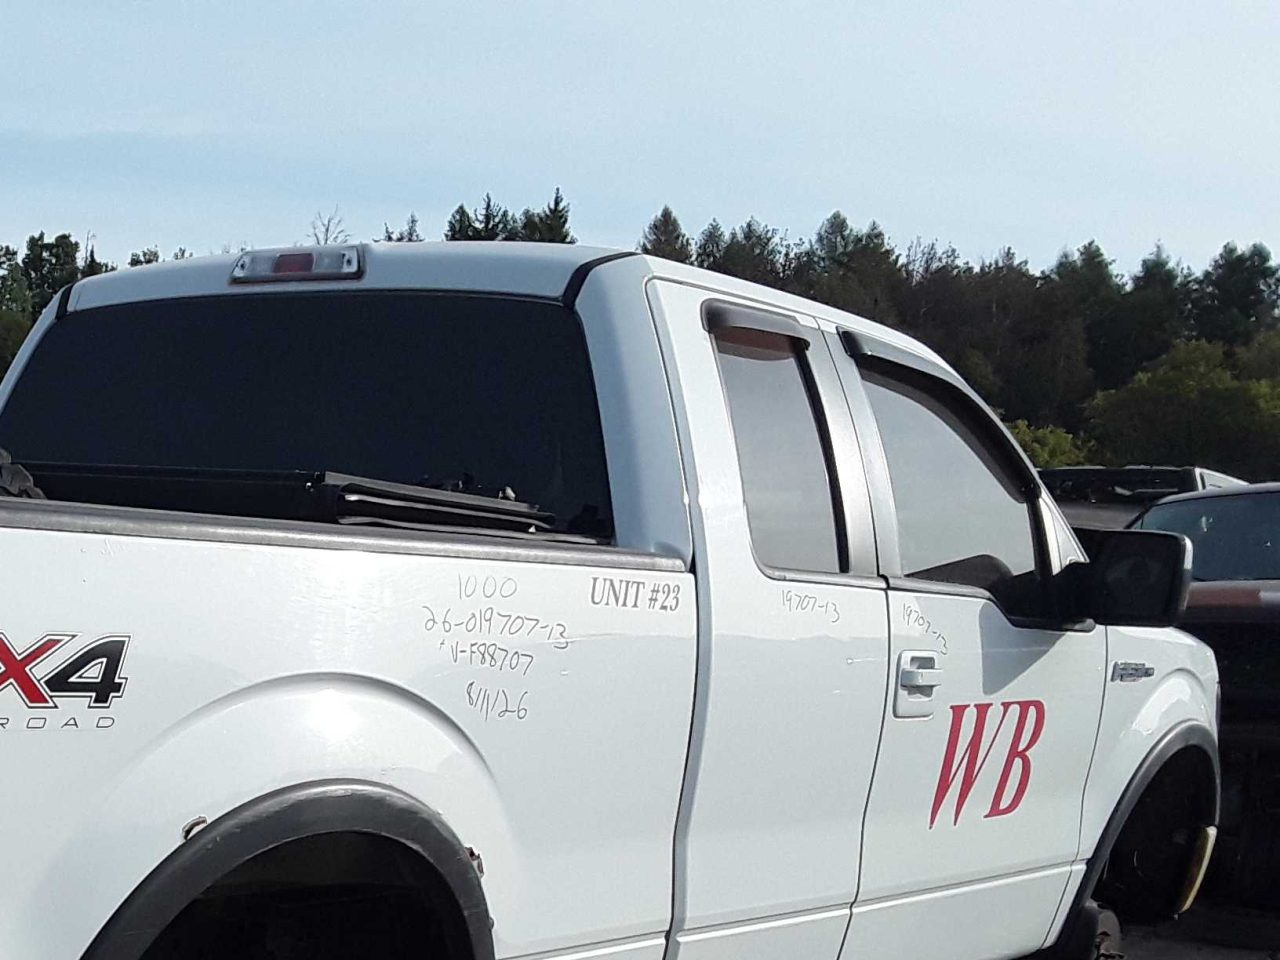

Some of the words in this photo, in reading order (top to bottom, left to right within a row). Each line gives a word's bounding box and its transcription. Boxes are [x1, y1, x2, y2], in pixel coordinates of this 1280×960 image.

[458, 573, 518, 600] 1000
[590, 577, 646, 609] UNIT
[648, 582, 681, 612] #23
[782, 589, 840, 623] 19707-13
[421, 605, 569, 649] 26-019707-13
[928, 699, 1047, 830] WB
